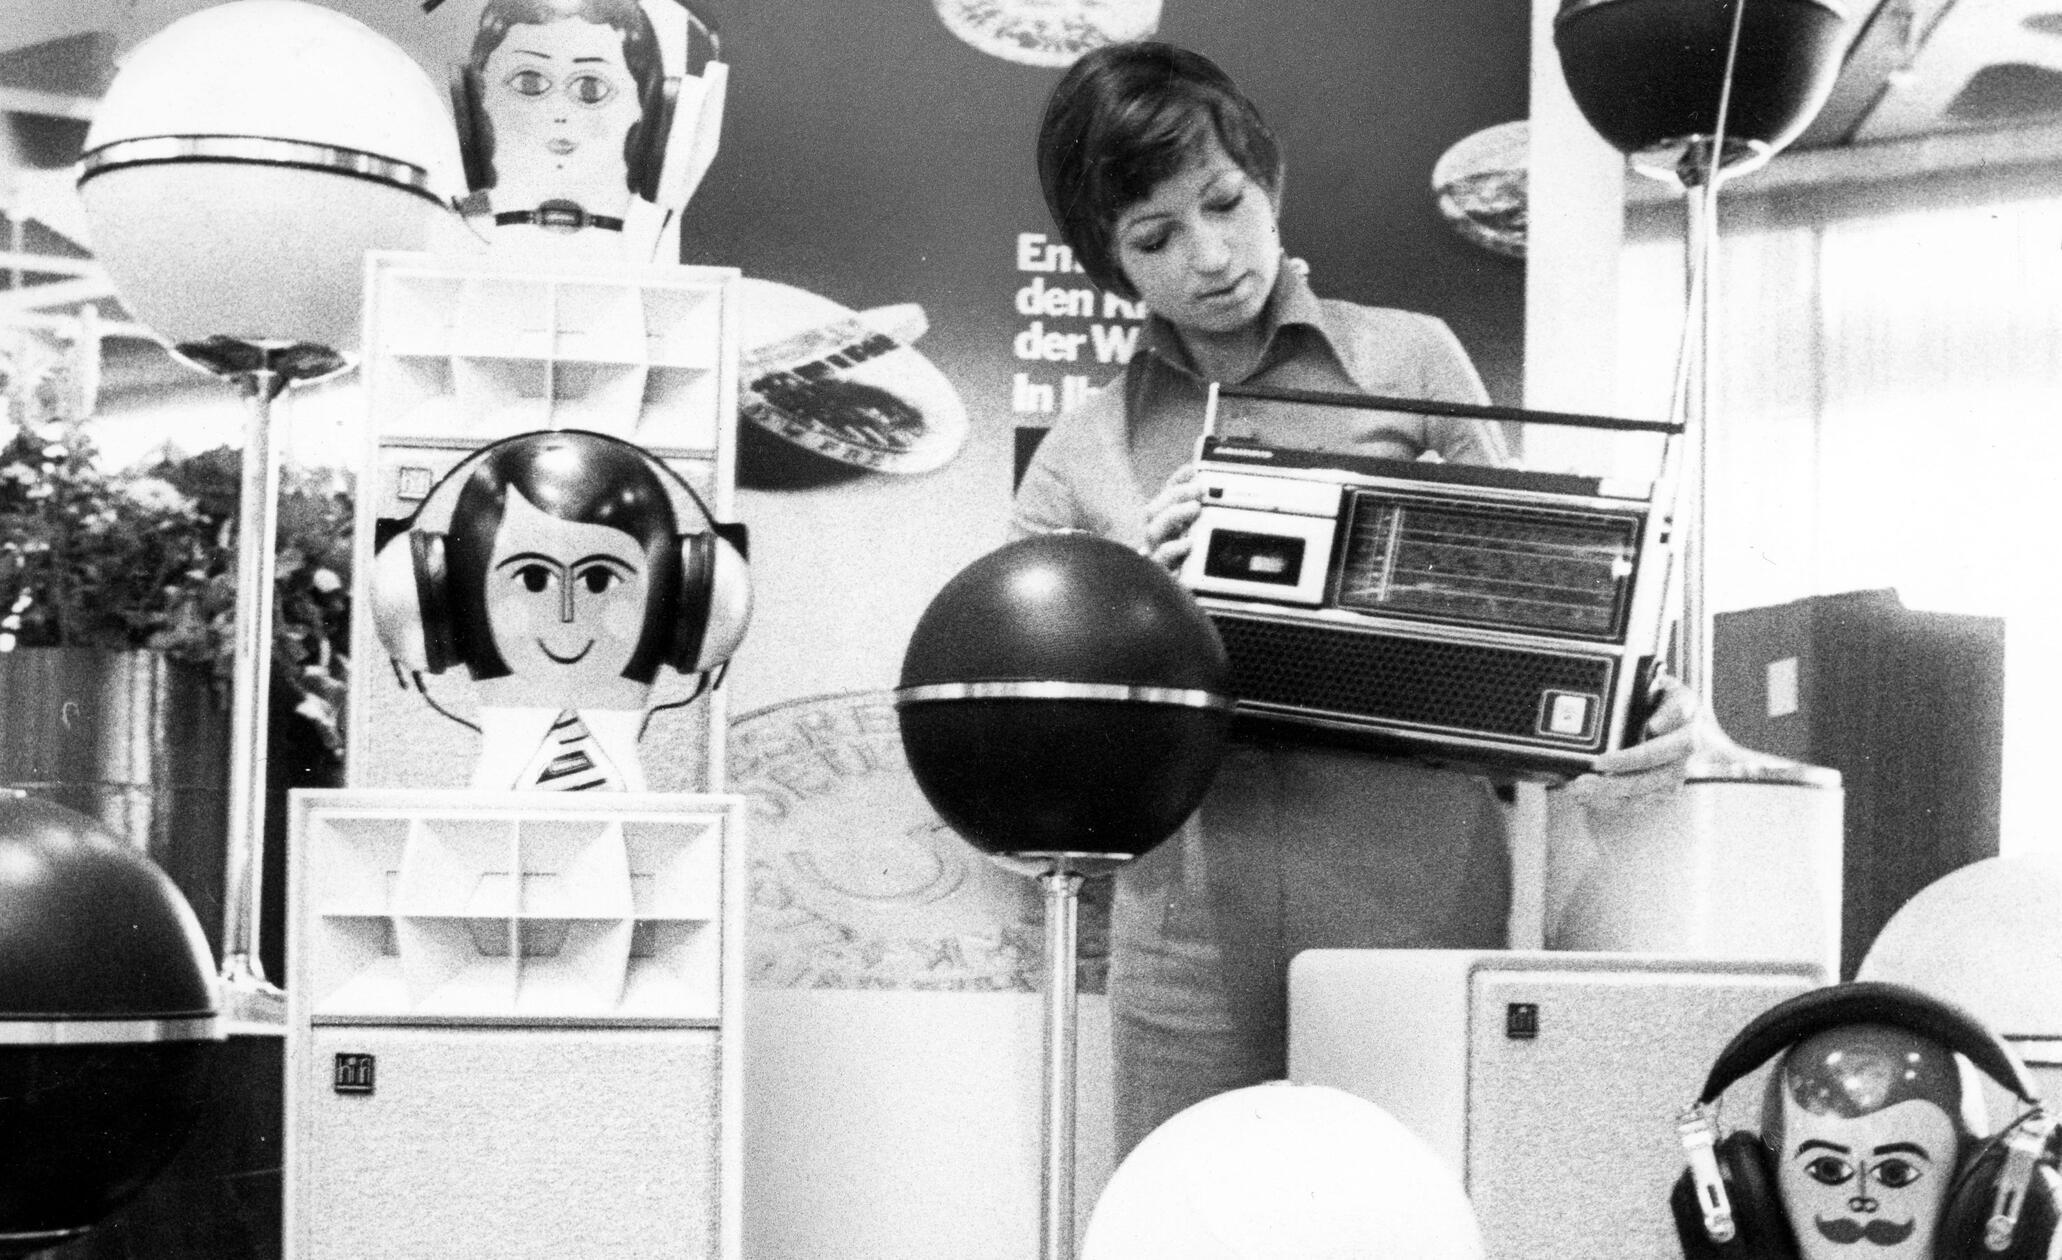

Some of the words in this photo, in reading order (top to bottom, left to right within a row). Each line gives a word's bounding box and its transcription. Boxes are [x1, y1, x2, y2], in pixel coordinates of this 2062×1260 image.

[1017, 233, 1085, 273] En
[1015, 277, 1094, 317] den
[1013, 321, 1087, 361] der
